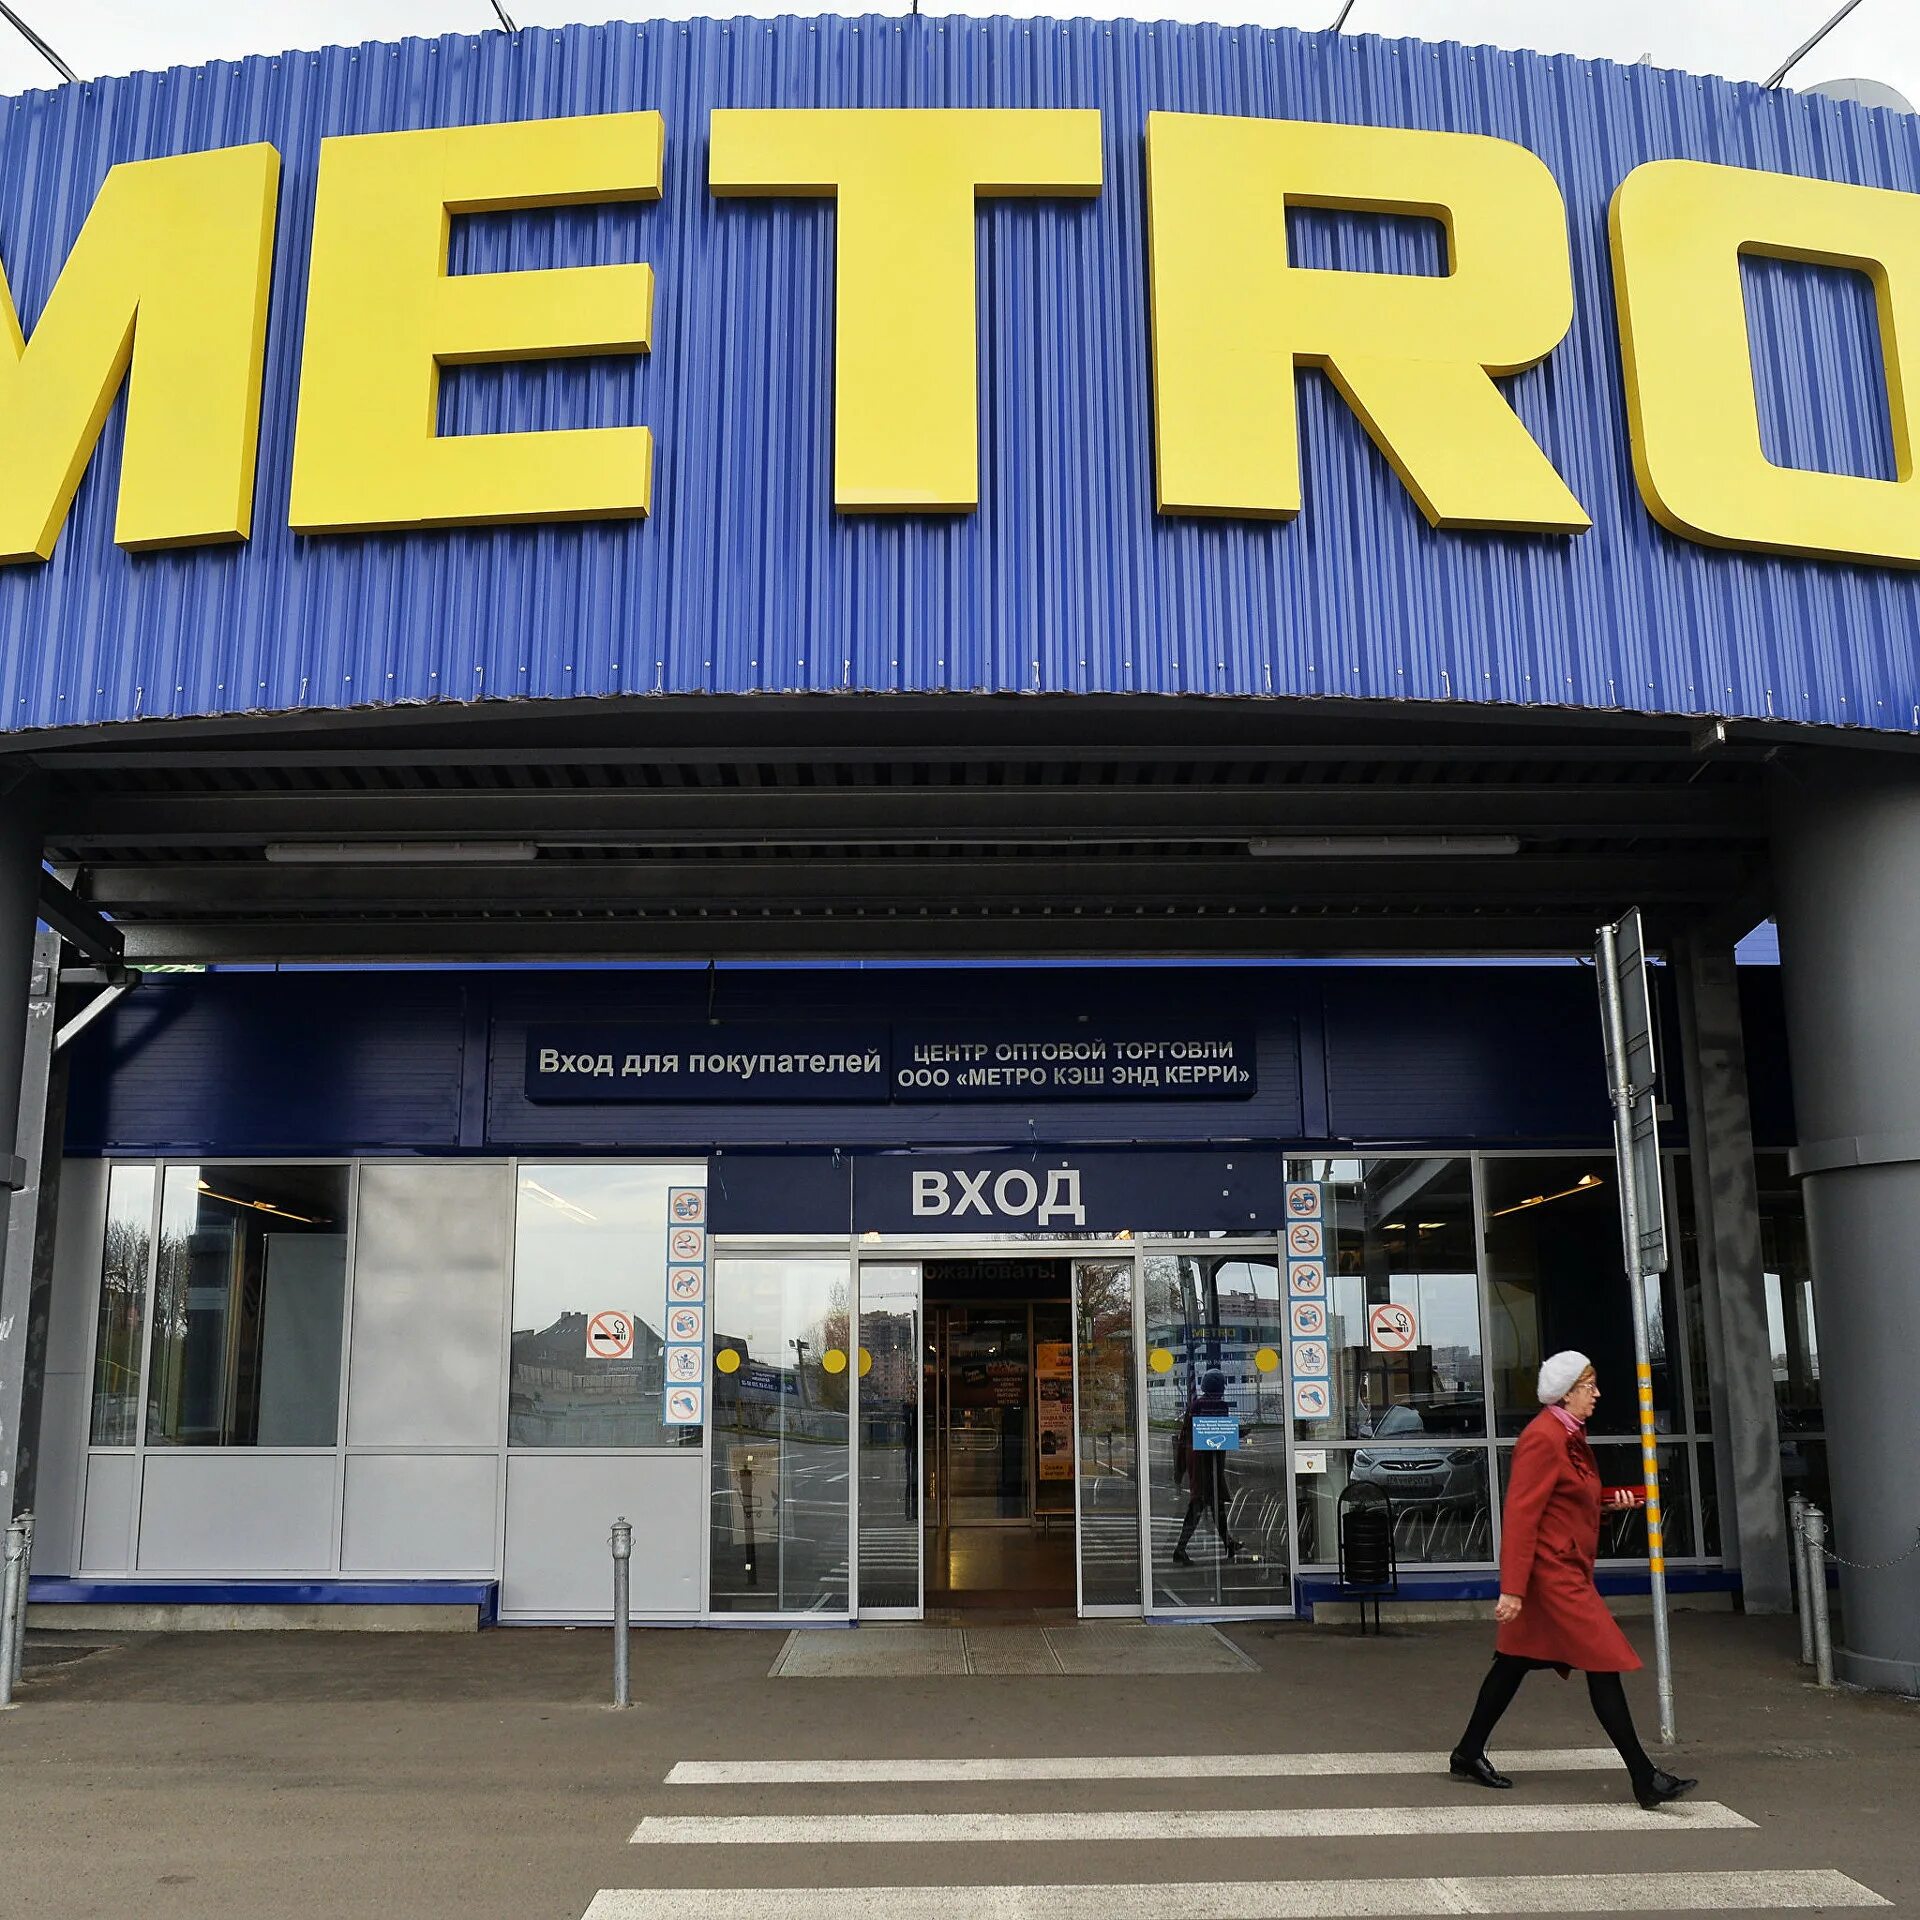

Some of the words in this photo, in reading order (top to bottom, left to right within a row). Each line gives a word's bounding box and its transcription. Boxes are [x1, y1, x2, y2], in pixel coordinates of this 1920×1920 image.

[0, 108, 1920, 569] METRO
[539, 1048, 614, 1077] Вход
[621, 1054, 679, 1077] для
[689, 1048, 881, 1079] покупателей
[914, 1044, 988, 1065] ЦЕНТР
[995, 1038, 1106, 1061] ОПТОВОЙ
[1113, 1041, 1234, 1060] ТОРГОВЛИ
[897, 1068, 950, 1087] ООО
[956, 1067, 1047, 1086] «МЕТРО
[1054, 1067, 1104, 1085] КЭШ
[1111, 1066, 1159, 1087] ЭНД
[1165, 1065, 1250, 1084] КЕРРИ»
[912, 1169, 1086, 1226] ВХОД
[923, 1261, 1056, 1280] ожаловать!
